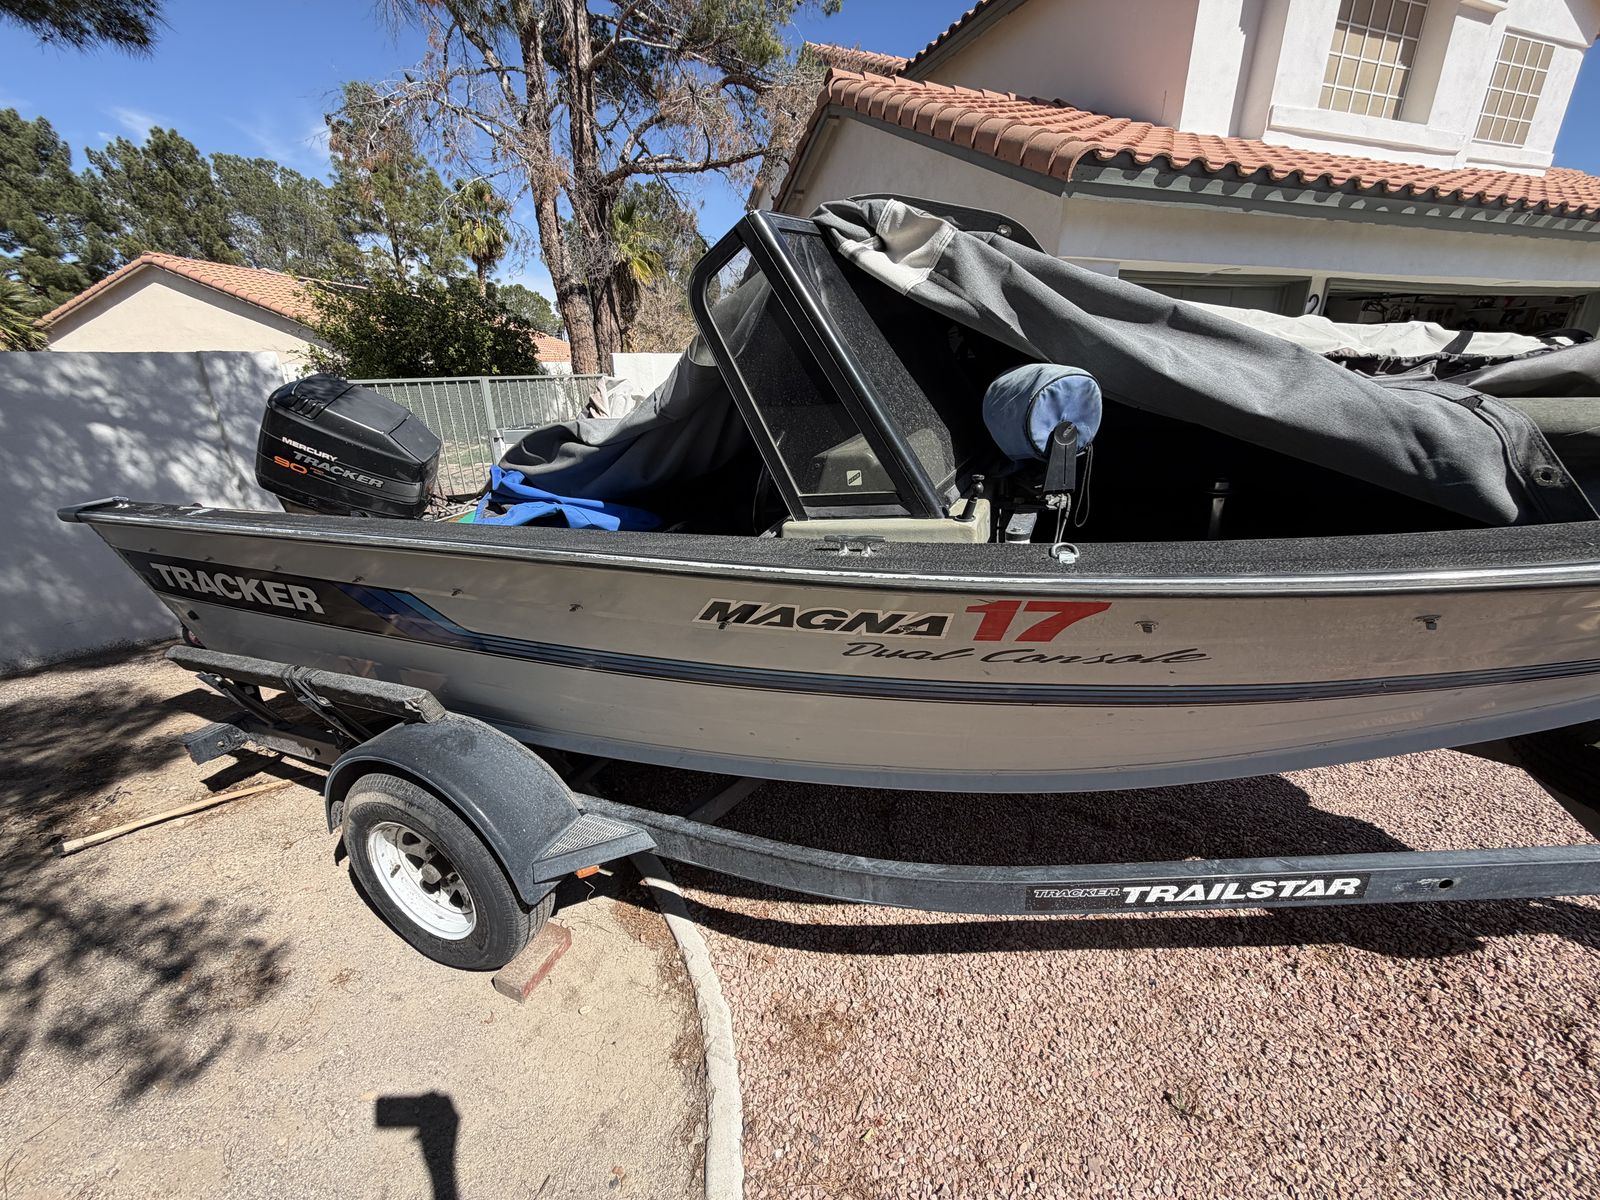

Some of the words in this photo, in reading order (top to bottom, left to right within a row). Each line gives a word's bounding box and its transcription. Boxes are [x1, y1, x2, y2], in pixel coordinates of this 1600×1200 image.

[282, 436, 338, 462] MERCURY
[274, 455, 308, 475] 90
[293, 450, 384, 488] TRACKER
[150, 562, 325, 615] TRACKER
[699, 601, 949, 637] MAGNA
[965, 600, 1112, 642] 17
[842, 641, 975, 661] Dual
[980, 648, 1212, 664] Console
[1034, 887, 1120, 898] TRACKER
[1122, 877, 1361, 904] TRAILSTAR
